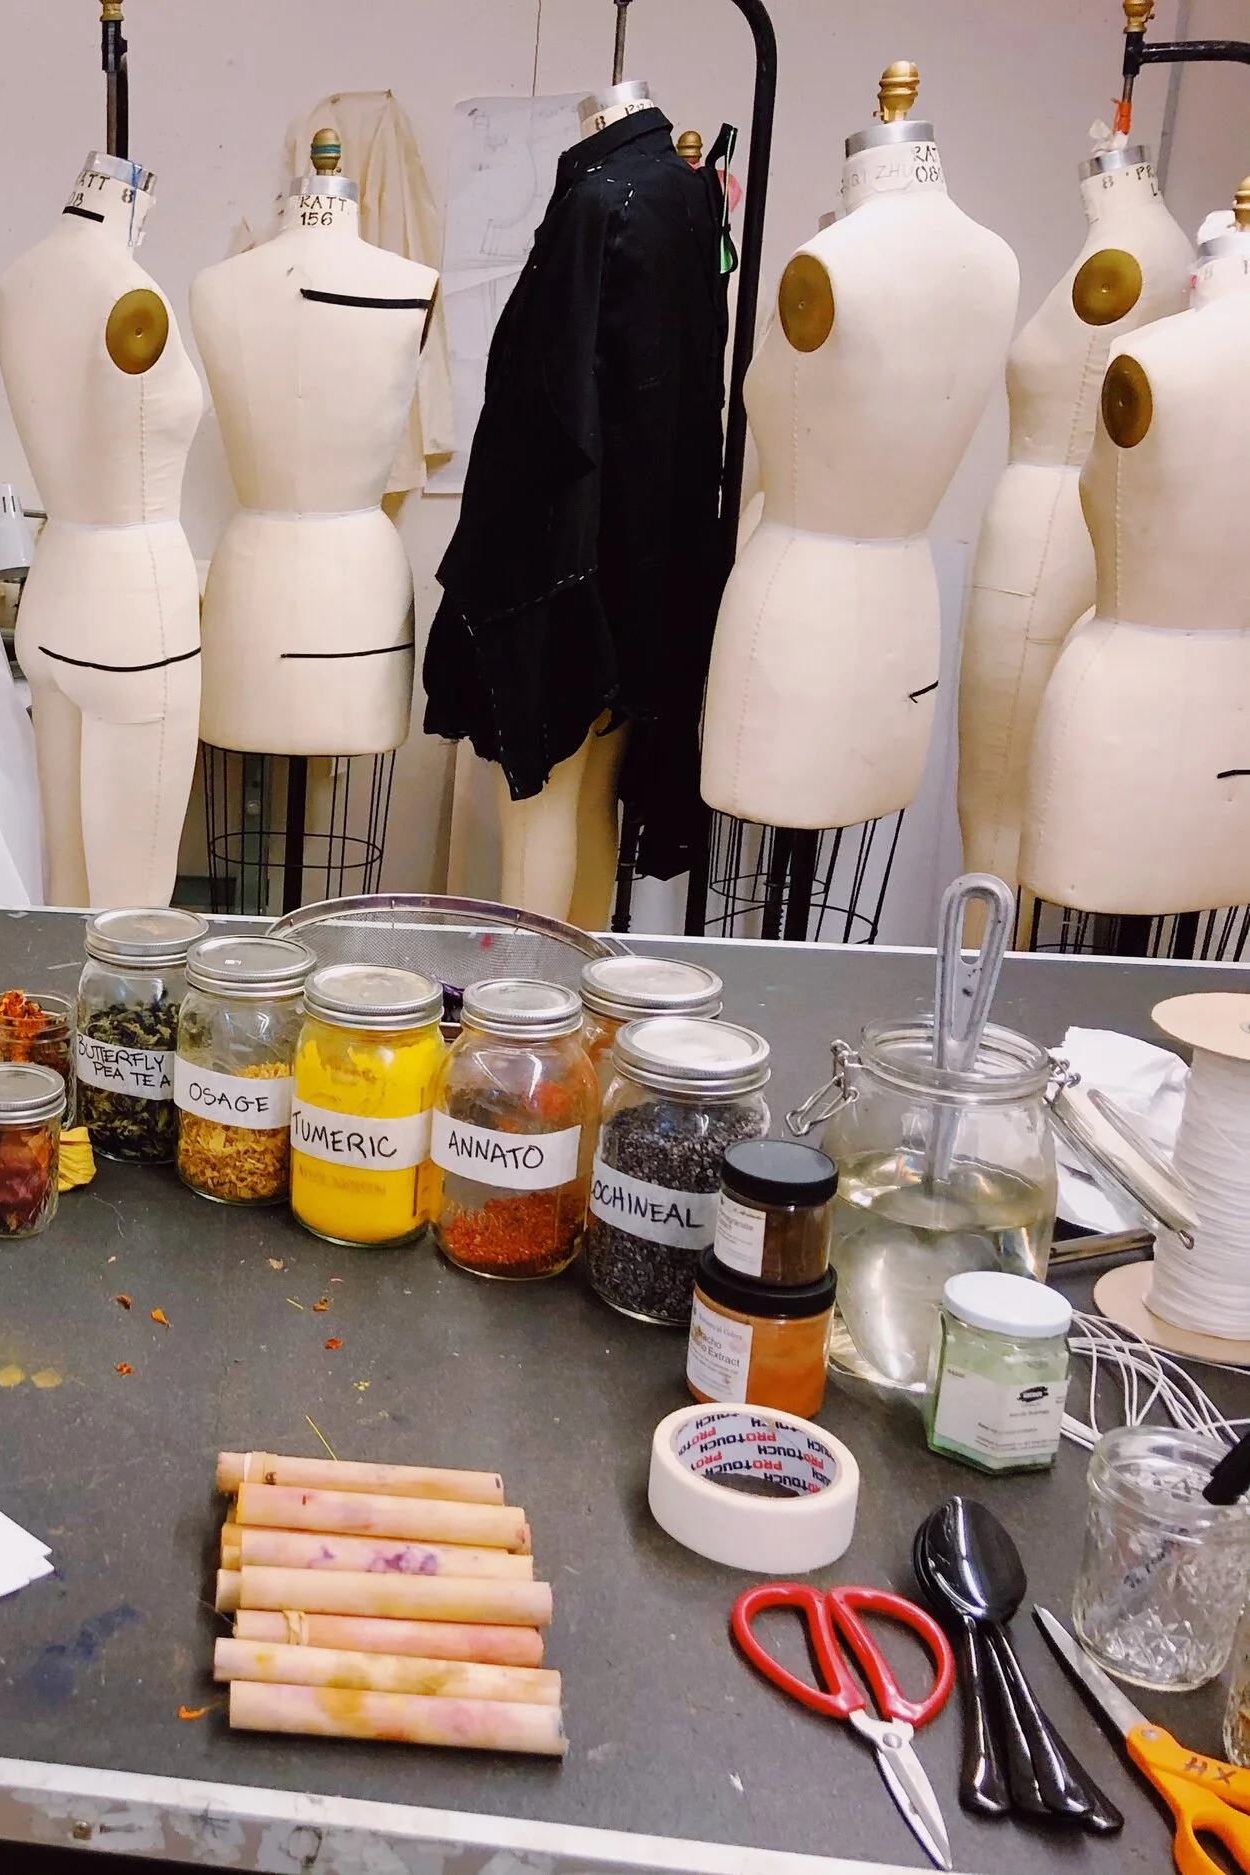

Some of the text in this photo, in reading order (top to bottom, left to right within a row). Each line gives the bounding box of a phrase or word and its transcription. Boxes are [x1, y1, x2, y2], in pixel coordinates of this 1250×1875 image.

[300, 211, 333, 226] 156
[77, 1034, 165, 1073] BUTTERFLY
[92, 1060, 125, 1082] PEA
[189, 1082, 270, 1114] OSAGE
[292, 1110, 398, 1159] TUMERIC
[448, 1130, 545, 1170] ANNATO
[591, 1179, 705, 1229] OCHINEAL
